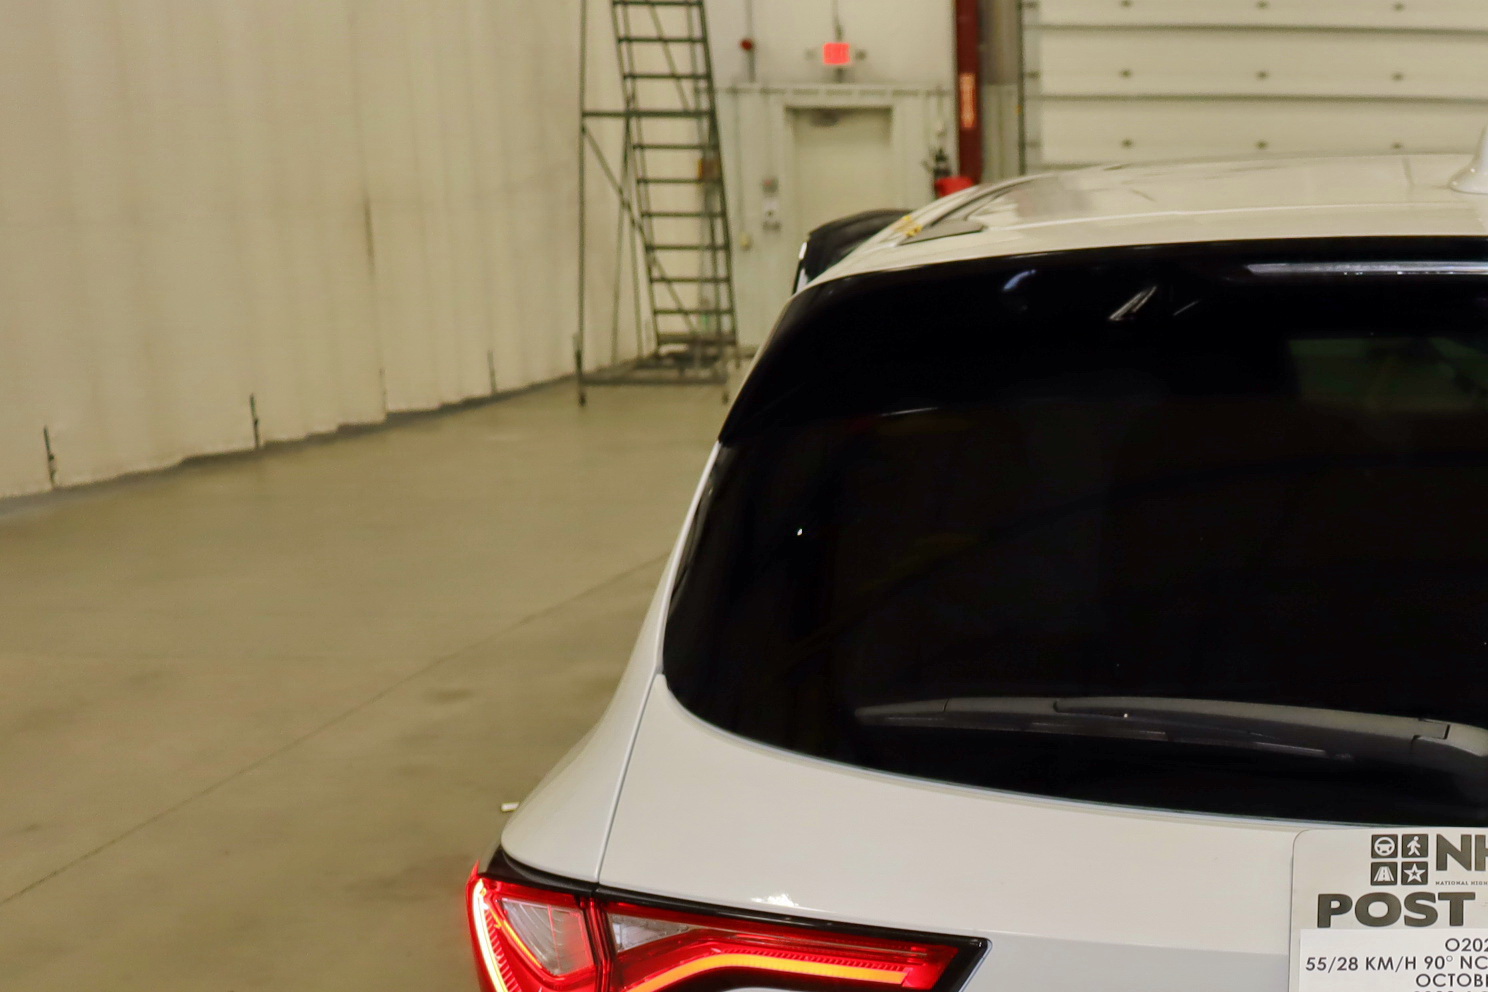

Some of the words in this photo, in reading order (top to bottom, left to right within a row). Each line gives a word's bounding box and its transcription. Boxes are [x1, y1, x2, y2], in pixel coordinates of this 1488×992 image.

[1317, 892, 1475, 928] POST
[1306, 957, 1358, 973] 55/28
[1366, 956, 1416, 972] KM/H
